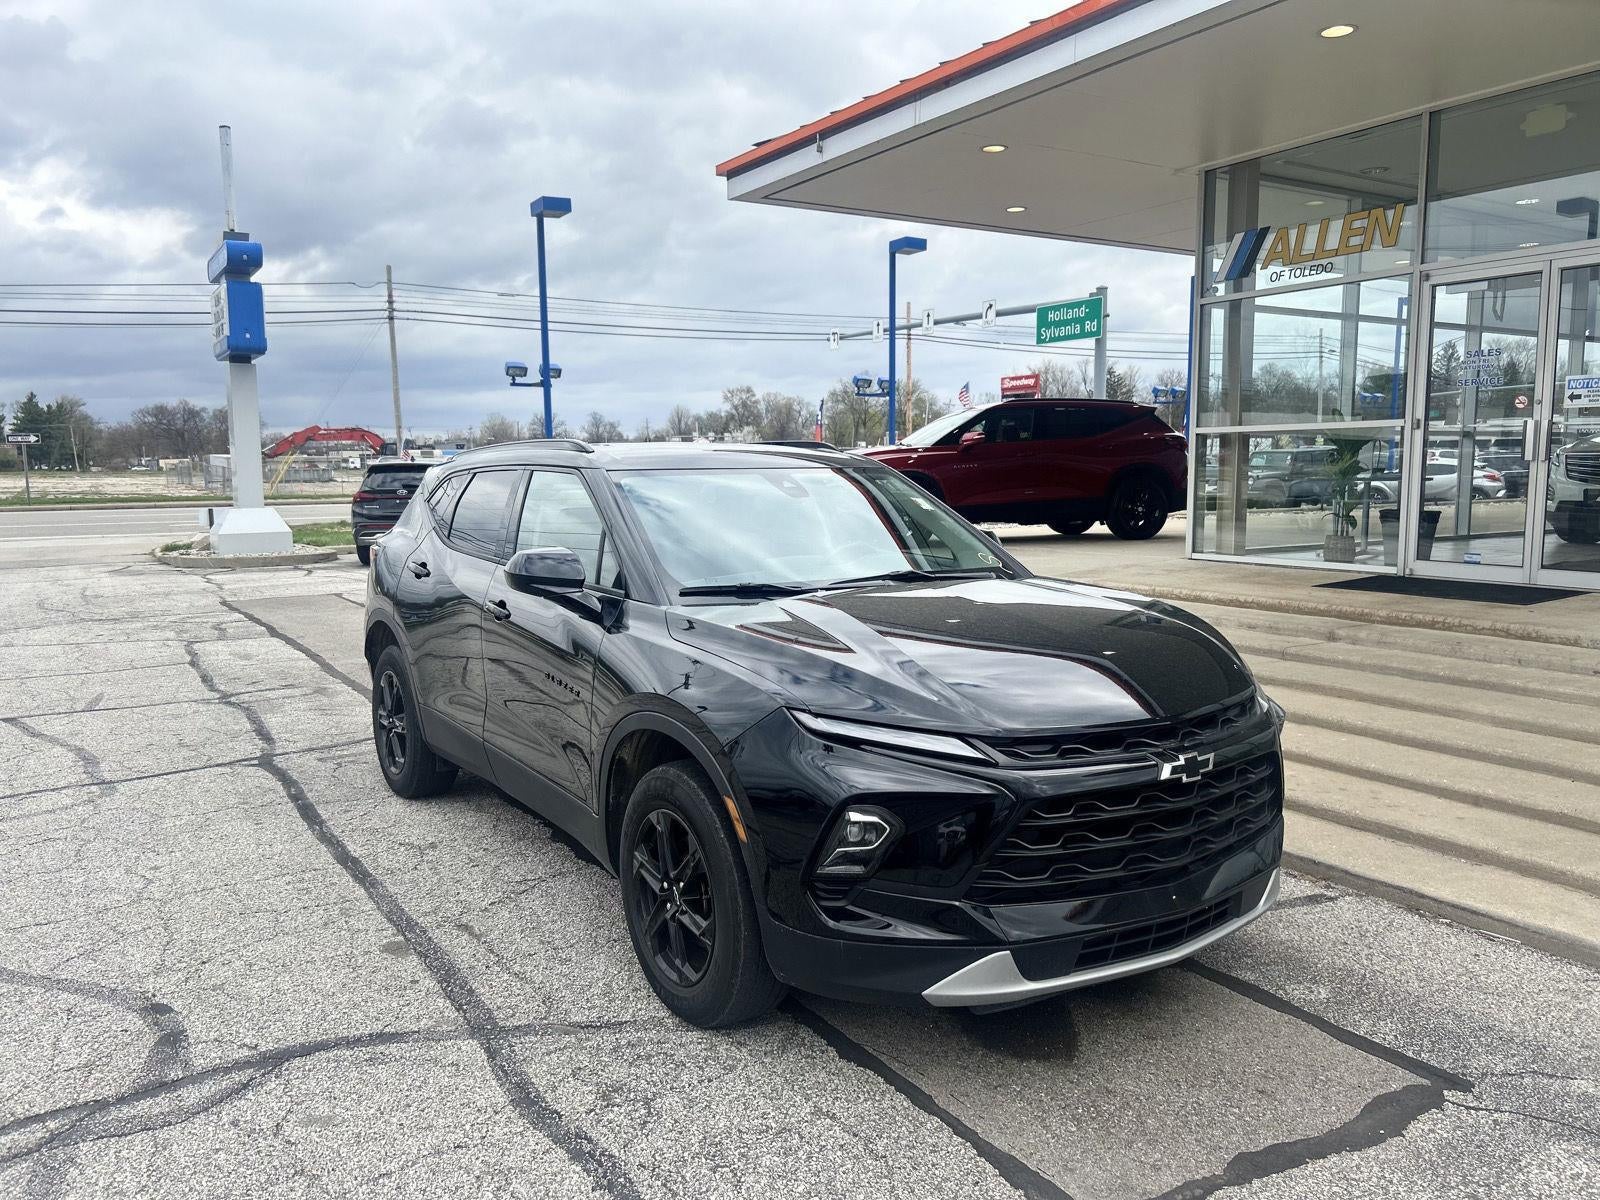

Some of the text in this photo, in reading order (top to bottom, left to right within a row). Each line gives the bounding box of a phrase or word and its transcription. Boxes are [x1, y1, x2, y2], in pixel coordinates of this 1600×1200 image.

[1260, 202, 1406, 270] ALLEN
[1270, 261, 1334, 283] OF TOLEDO
[1048, 304, 1089, 322] Holland-
[1040, 318, 1097, 341] Sylvania Rd
[1466, 348, 1502, 359] SALES
[1460, 362, 1495, 370] SATURDAY
[1003, 377, 1036, 388] Speedway
[1457, 376, 1503, 387] SERVICE
[1569, 378, 1600, 389] NOTIC
